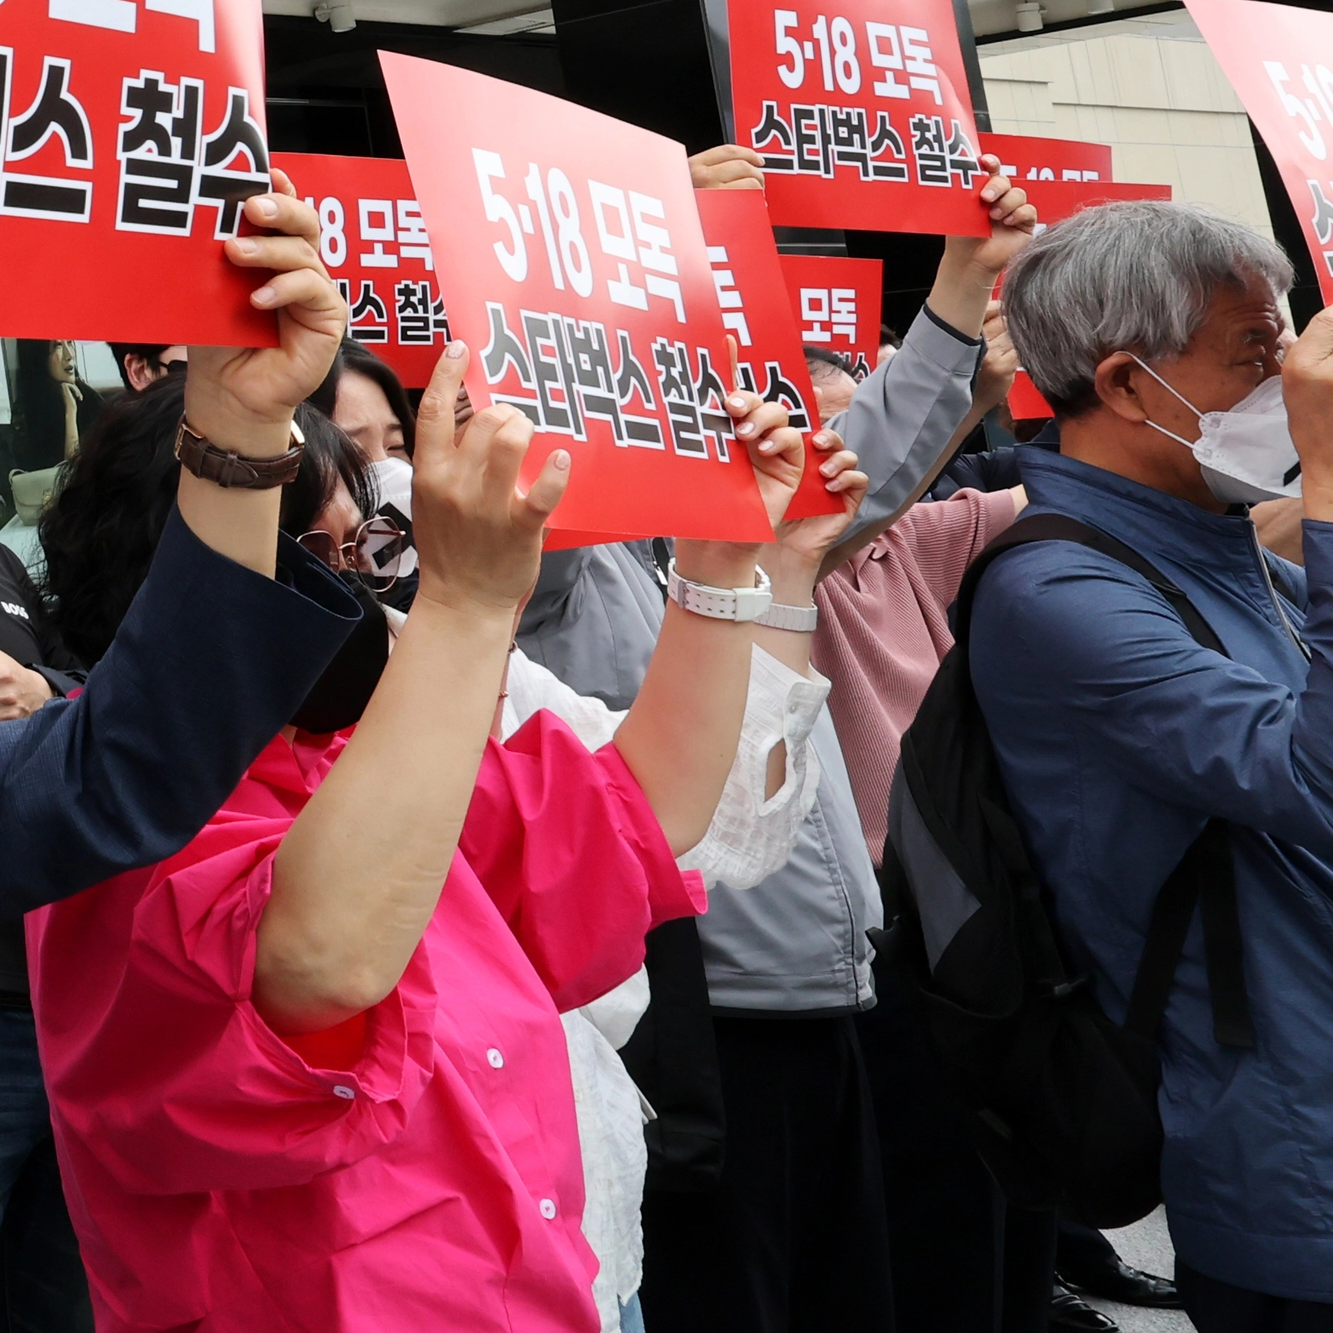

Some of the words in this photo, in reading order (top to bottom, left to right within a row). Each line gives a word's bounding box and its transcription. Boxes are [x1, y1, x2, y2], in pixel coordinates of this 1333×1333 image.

[865, 21, 944, 106] 모독
[115, 68, 271, 241] 철수
[750, 100, 909, 183] 스타벅스
[909, 113, 983, 190] 철수
[358, 198, 434, 271] 모독
[587, 178, 687, 324] 모독
[800, 288, 858, 345] 모독
[479, 301, 666, 450] 스타벅스
[650, 335, 737, 464] 철수
